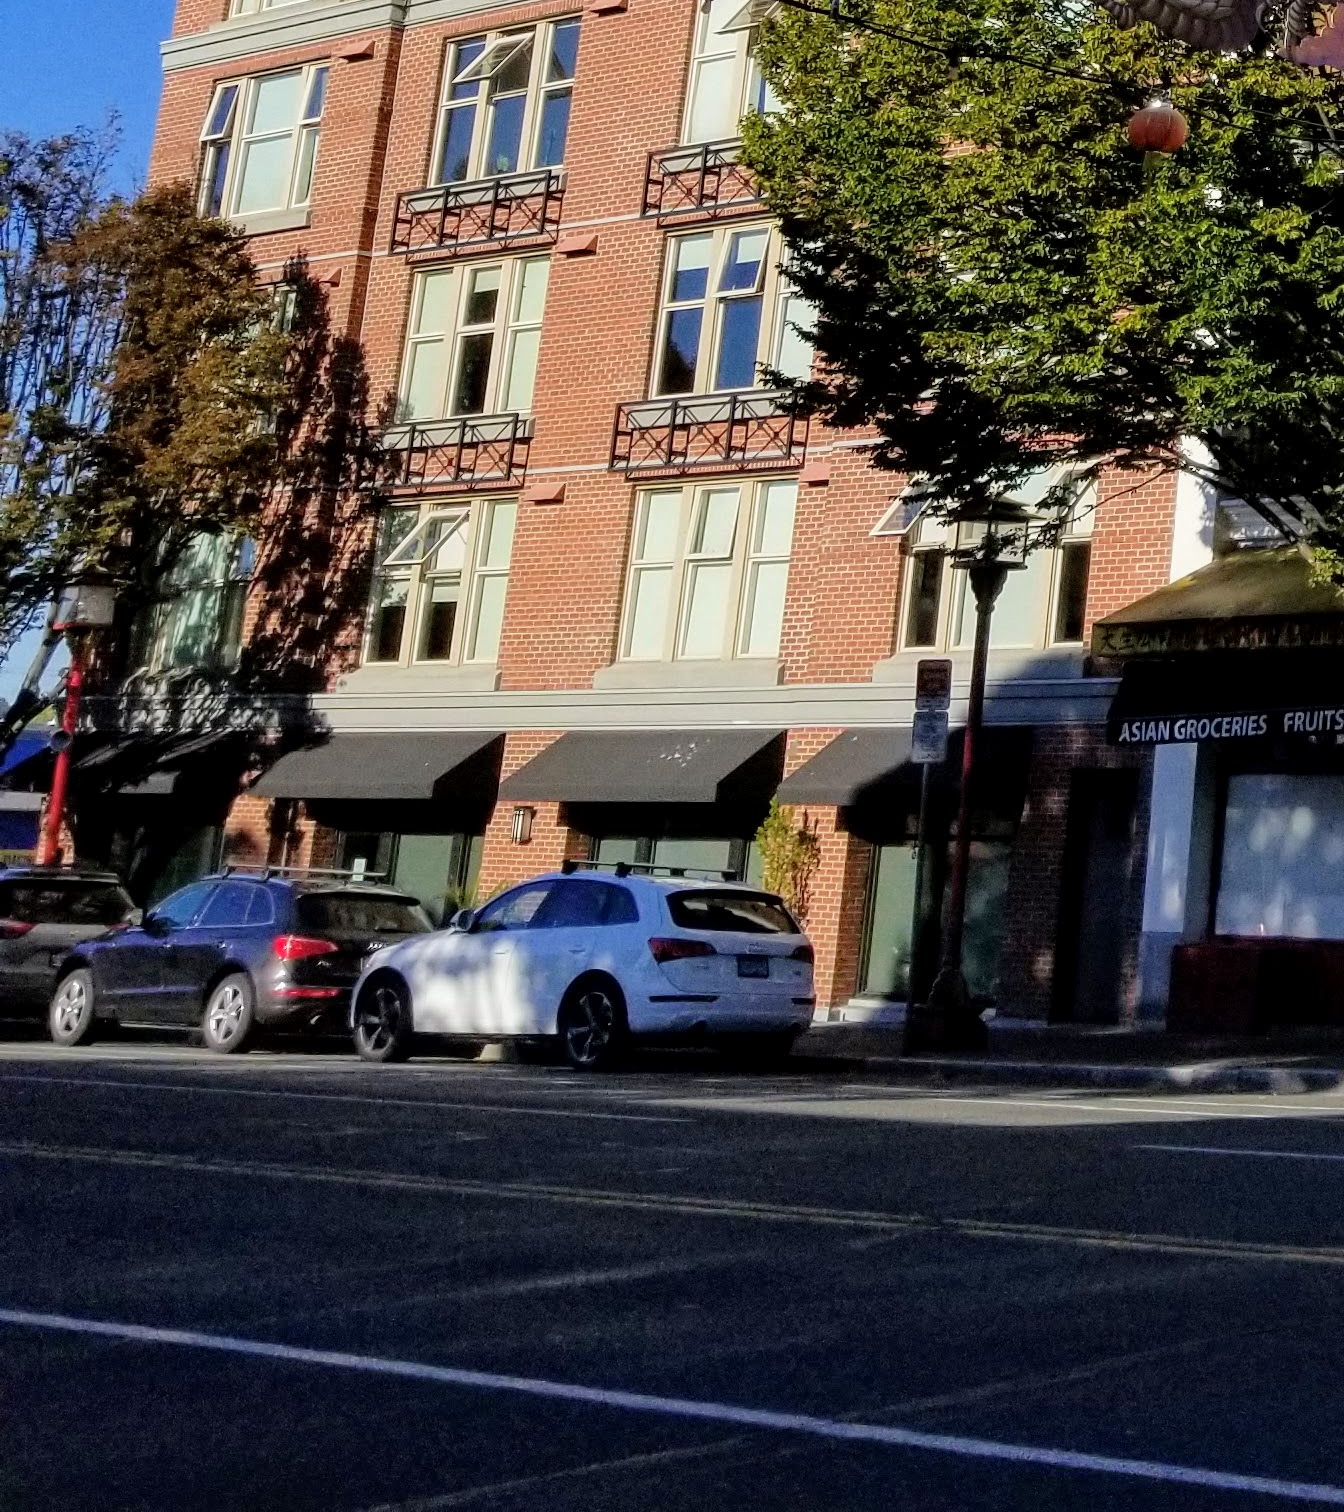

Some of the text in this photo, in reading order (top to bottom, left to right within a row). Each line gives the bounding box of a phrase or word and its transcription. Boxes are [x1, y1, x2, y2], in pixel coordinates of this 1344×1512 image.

[1118, 719, 1171, 743] ASIAN
[1173, 714, 1268, 740] GROCERIES
[1283, 708, 1344, 733] FRUITS
